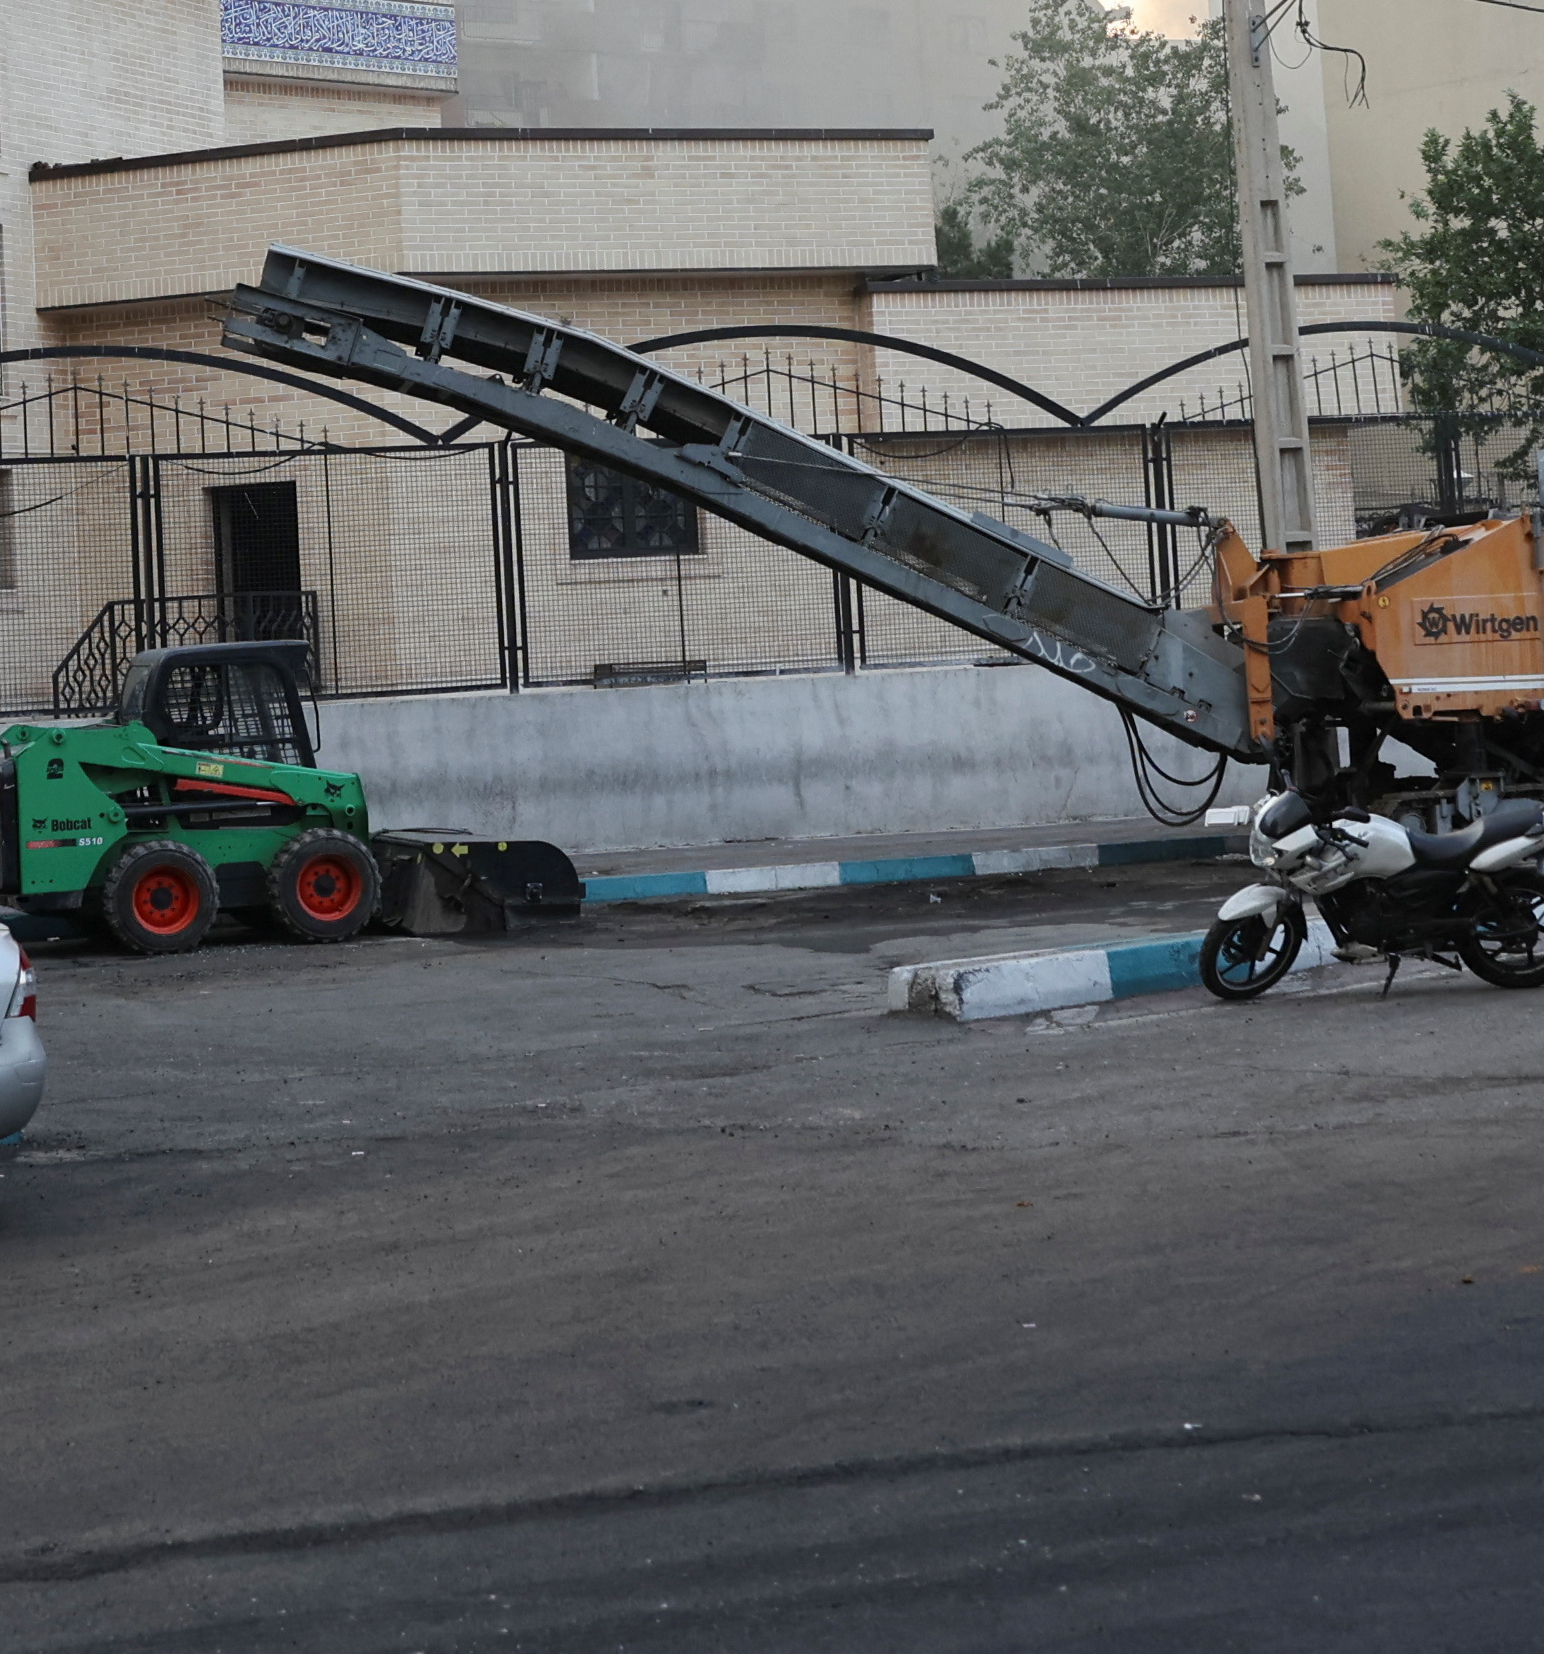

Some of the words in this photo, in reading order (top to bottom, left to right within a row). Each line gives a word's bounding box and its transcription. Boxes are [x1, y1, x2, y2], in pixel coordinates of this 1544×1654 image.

[1451, 613, 1539, 640] Wirtgen
[51, 817, 92, 833] Bobcat
[78, 837, 104, 847] S510
